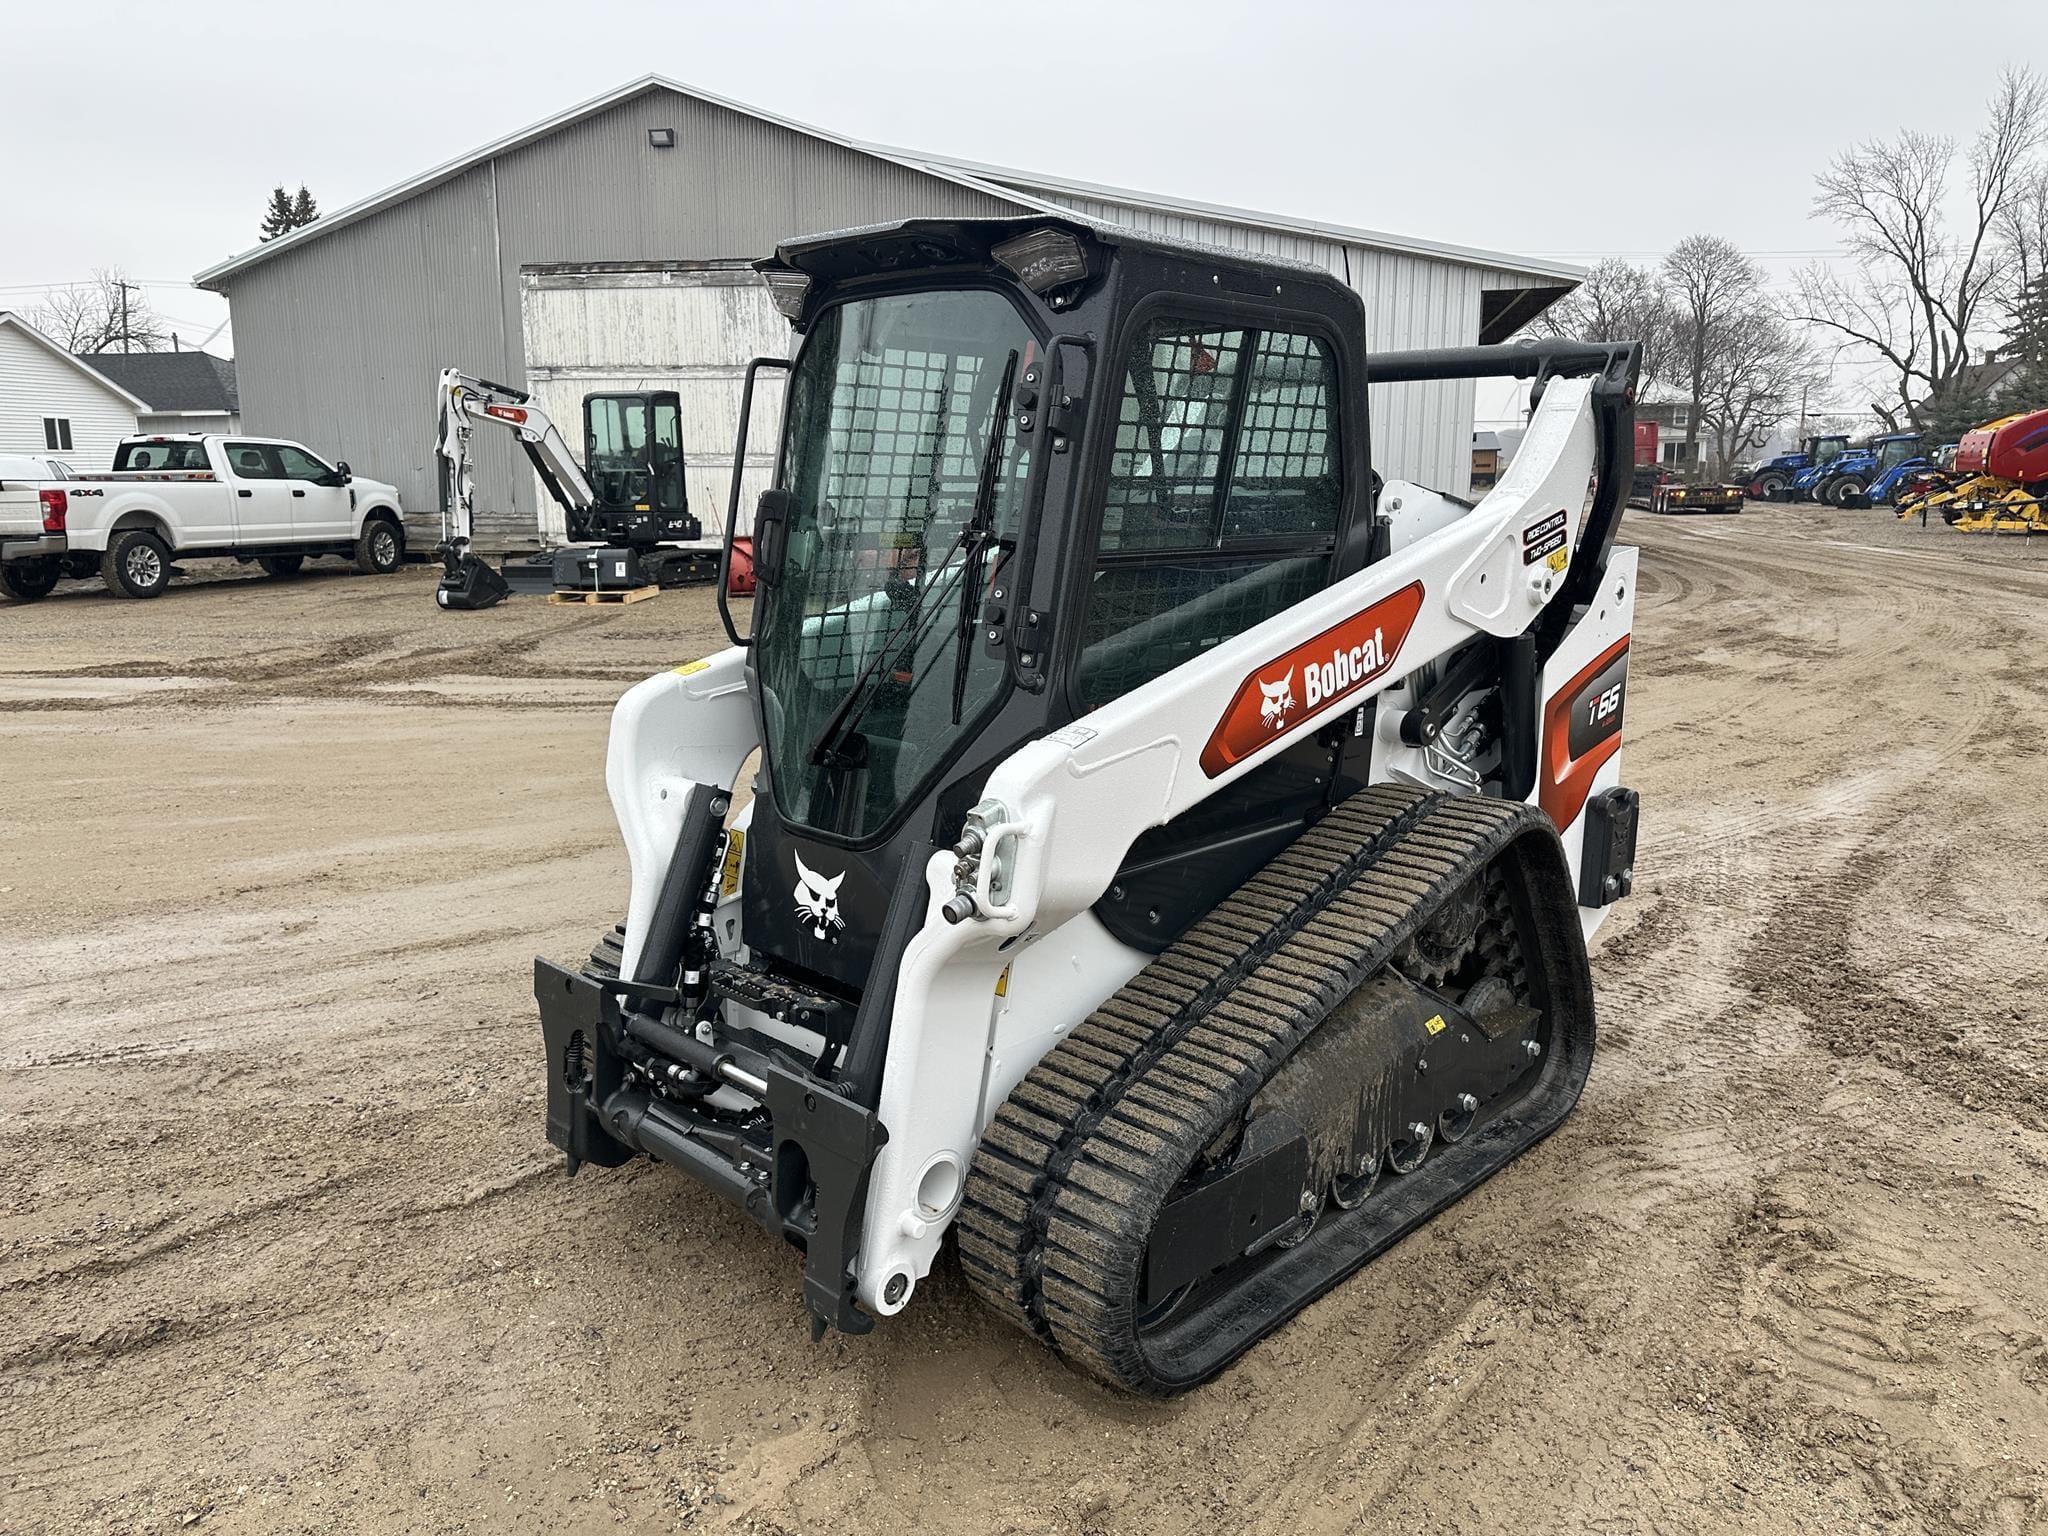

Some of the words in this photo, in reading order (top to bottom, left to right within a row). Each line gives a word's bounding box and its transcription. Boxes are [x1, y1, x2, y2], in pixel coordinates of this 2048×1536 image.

[1540, 513, 1565, 535] CONTROL
[1530, 534, 1563, 560] TWO-SPEED
[1303, 626, 1385, 709] Bobcat
[1589, 682, 1622, 726] T66
